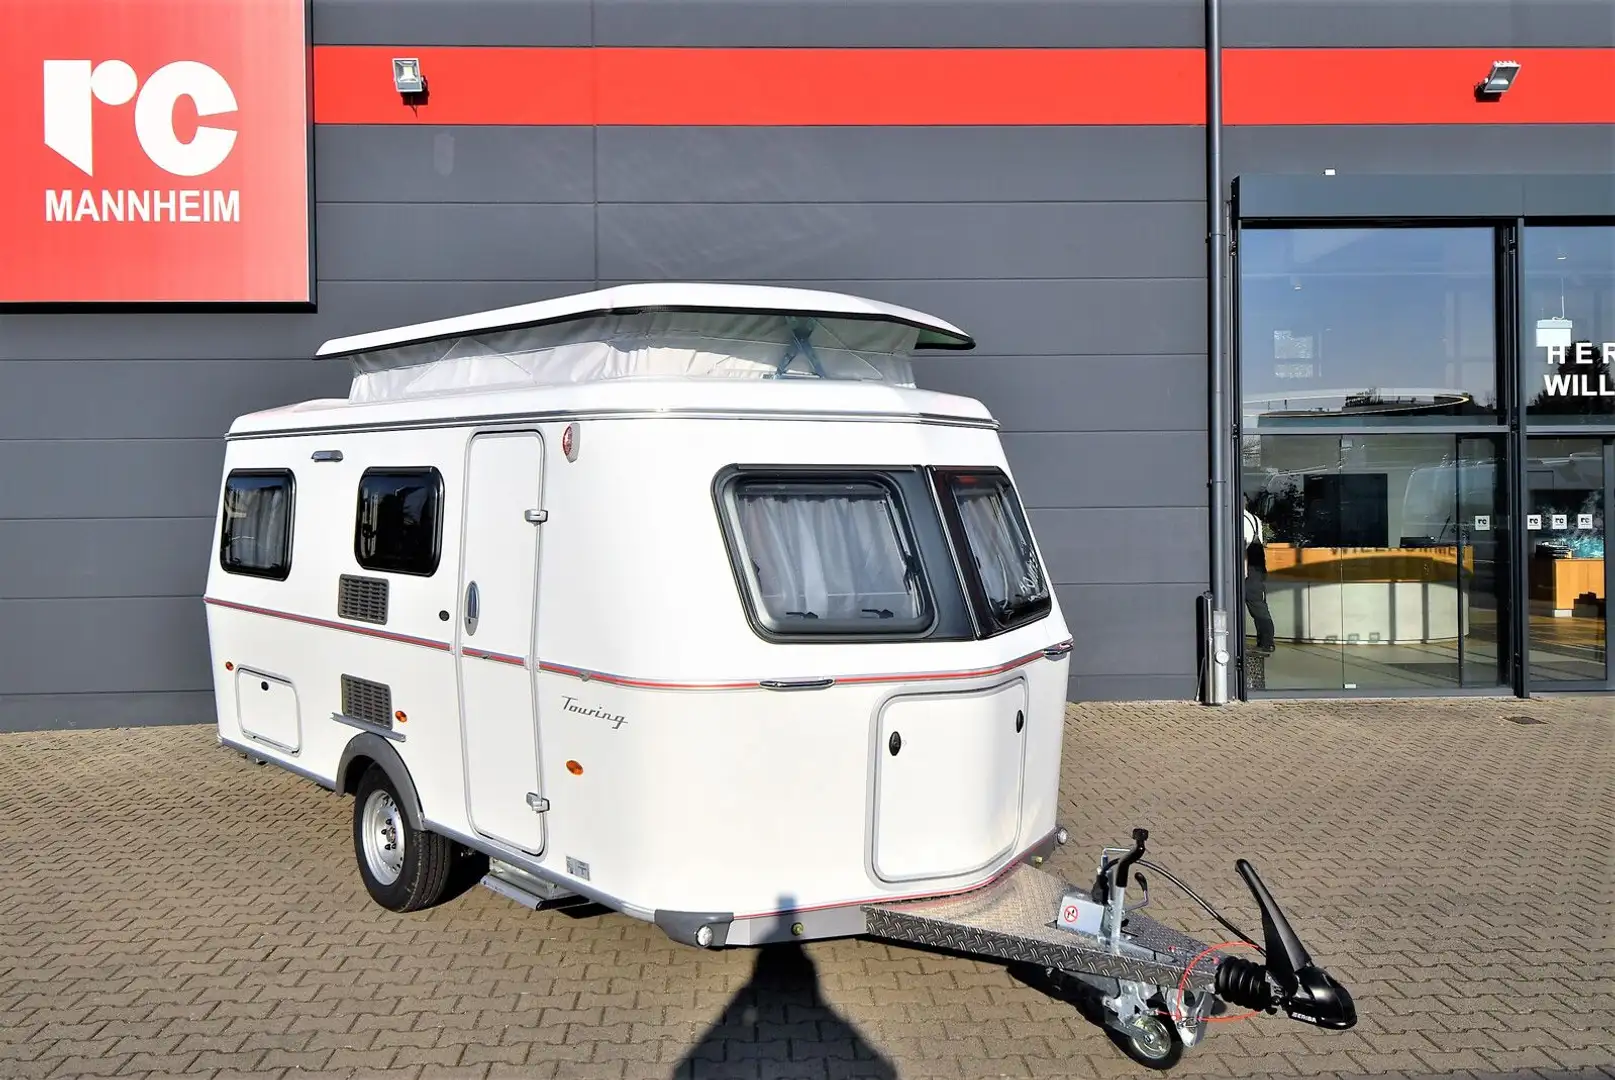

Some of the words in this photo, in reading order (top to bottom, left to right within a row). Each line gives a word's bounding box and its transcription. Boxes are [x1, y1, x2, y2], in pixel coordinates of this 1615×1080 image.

[43, 59, 239, 177] rc
[45, 189, 240, 222] MANNHEIM
[1543, 374, 1615, 396] WILL
[561, 695, 628, 729] Touring
